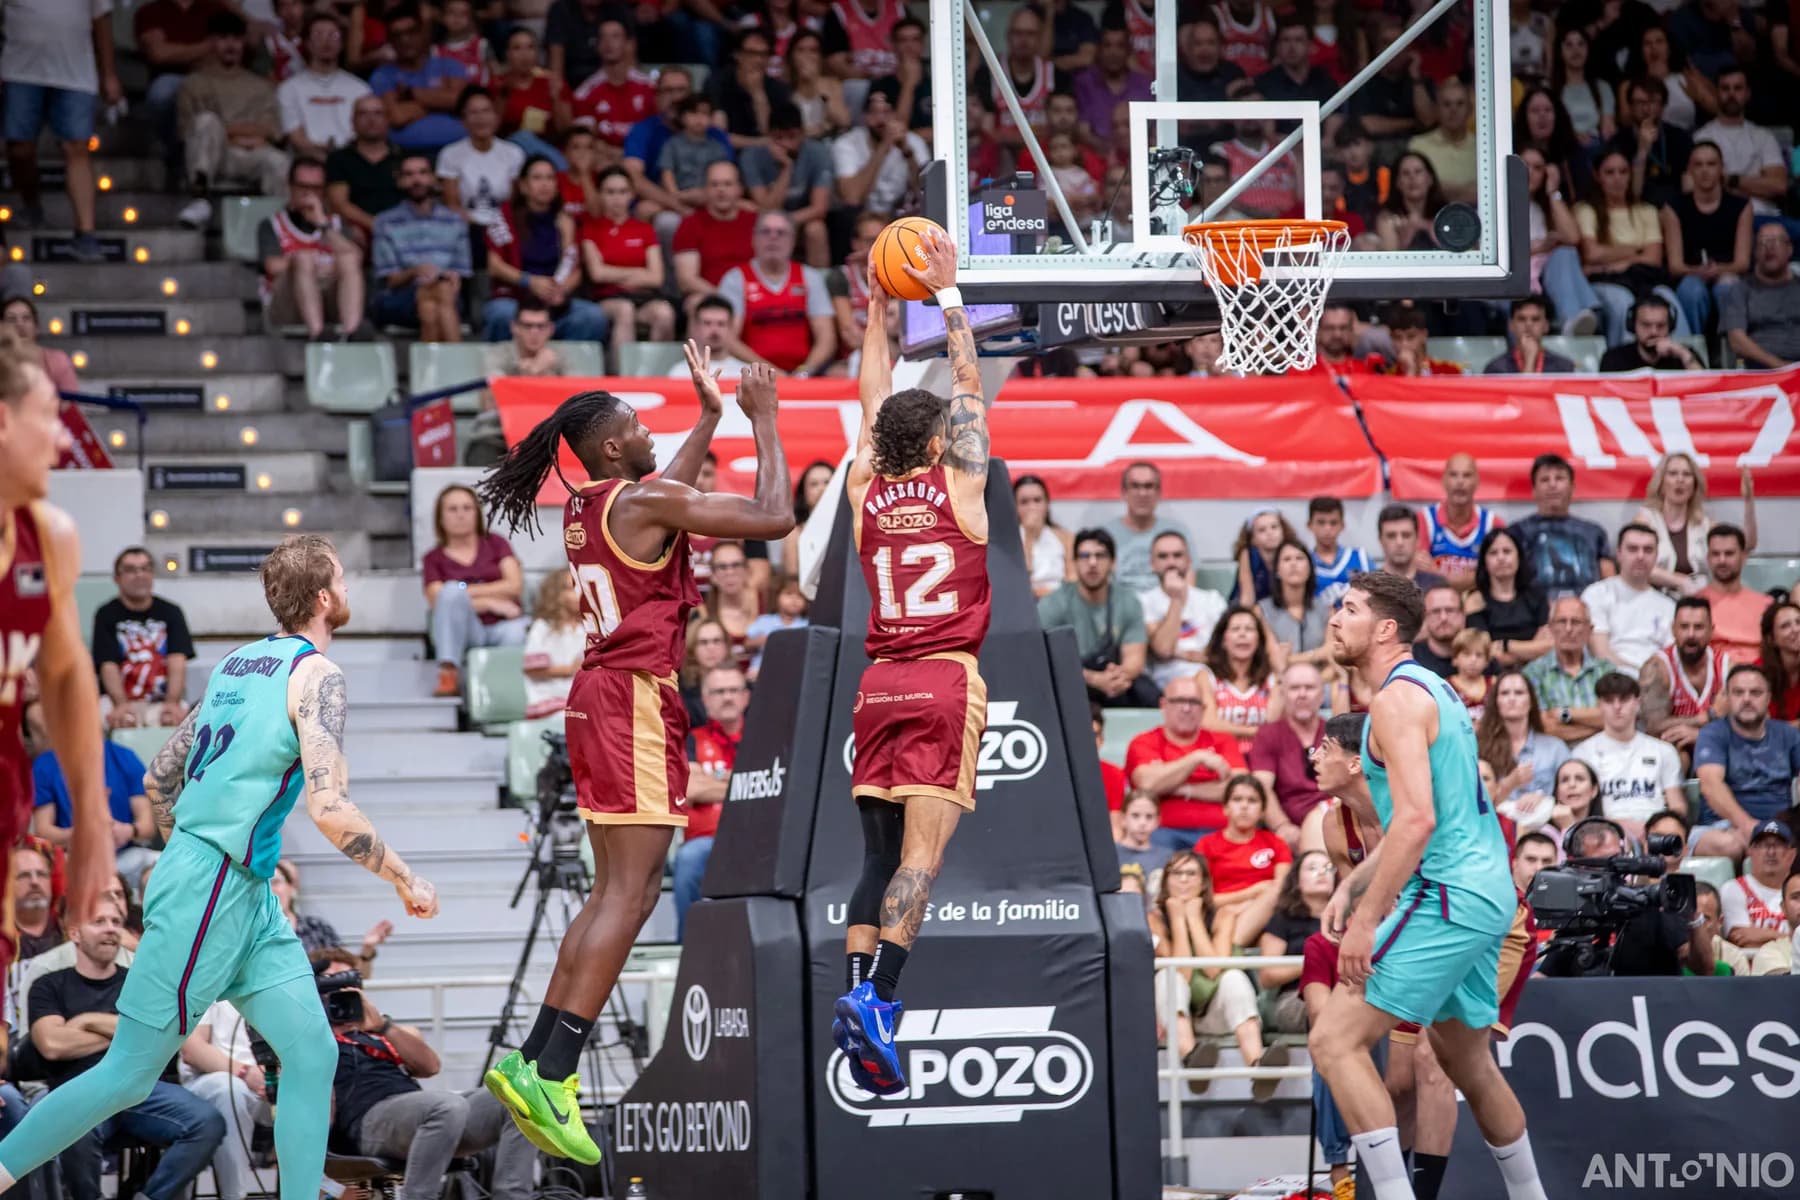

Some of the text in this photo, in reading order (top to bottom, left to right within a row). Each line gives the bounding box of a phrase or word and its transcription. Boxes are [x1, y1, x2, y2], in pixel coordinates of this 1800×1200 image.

[985, 203, 1013, 219] liga
[986, 217, 1045, 231] endesa
[872, 541, 959, 619] 12
[187, 723, 236, 782] 22
[938, 901, 966, 922] de
[971, 901, 993, 920] la
[996, 899, 1080, 925] familia
[714, 1007, 750, 1038] LABASA
[615, 1100, 751, 1152] LET'S GO BEYOND
